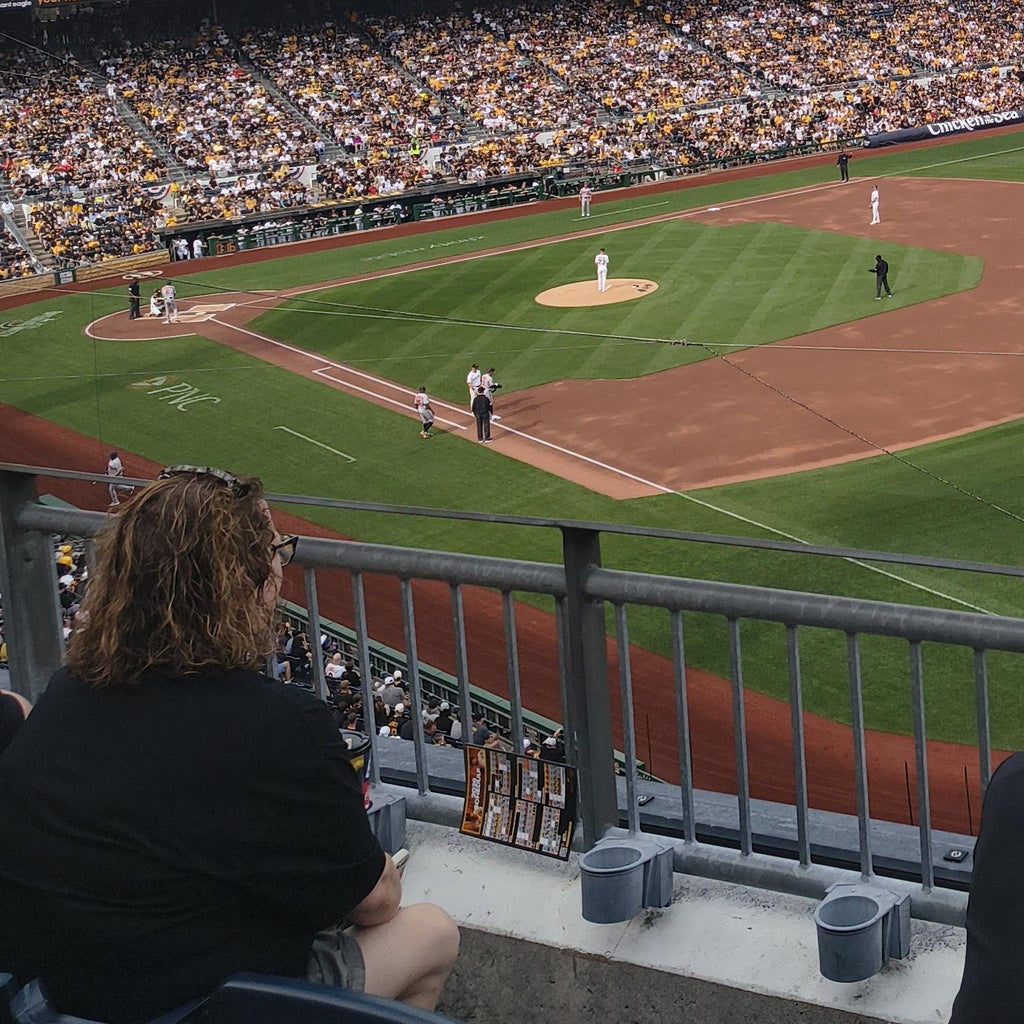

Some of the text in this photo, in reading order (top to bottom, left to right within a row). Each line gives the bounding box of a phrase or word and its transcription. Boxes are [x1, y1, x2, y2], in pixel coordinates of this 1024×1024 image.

[13, 0, 32, 8] eagle
[927, 114, 984, 135] Chicken
[991, 111, 1019, 123] Sea
[147, 383, 221, 412] PNC
